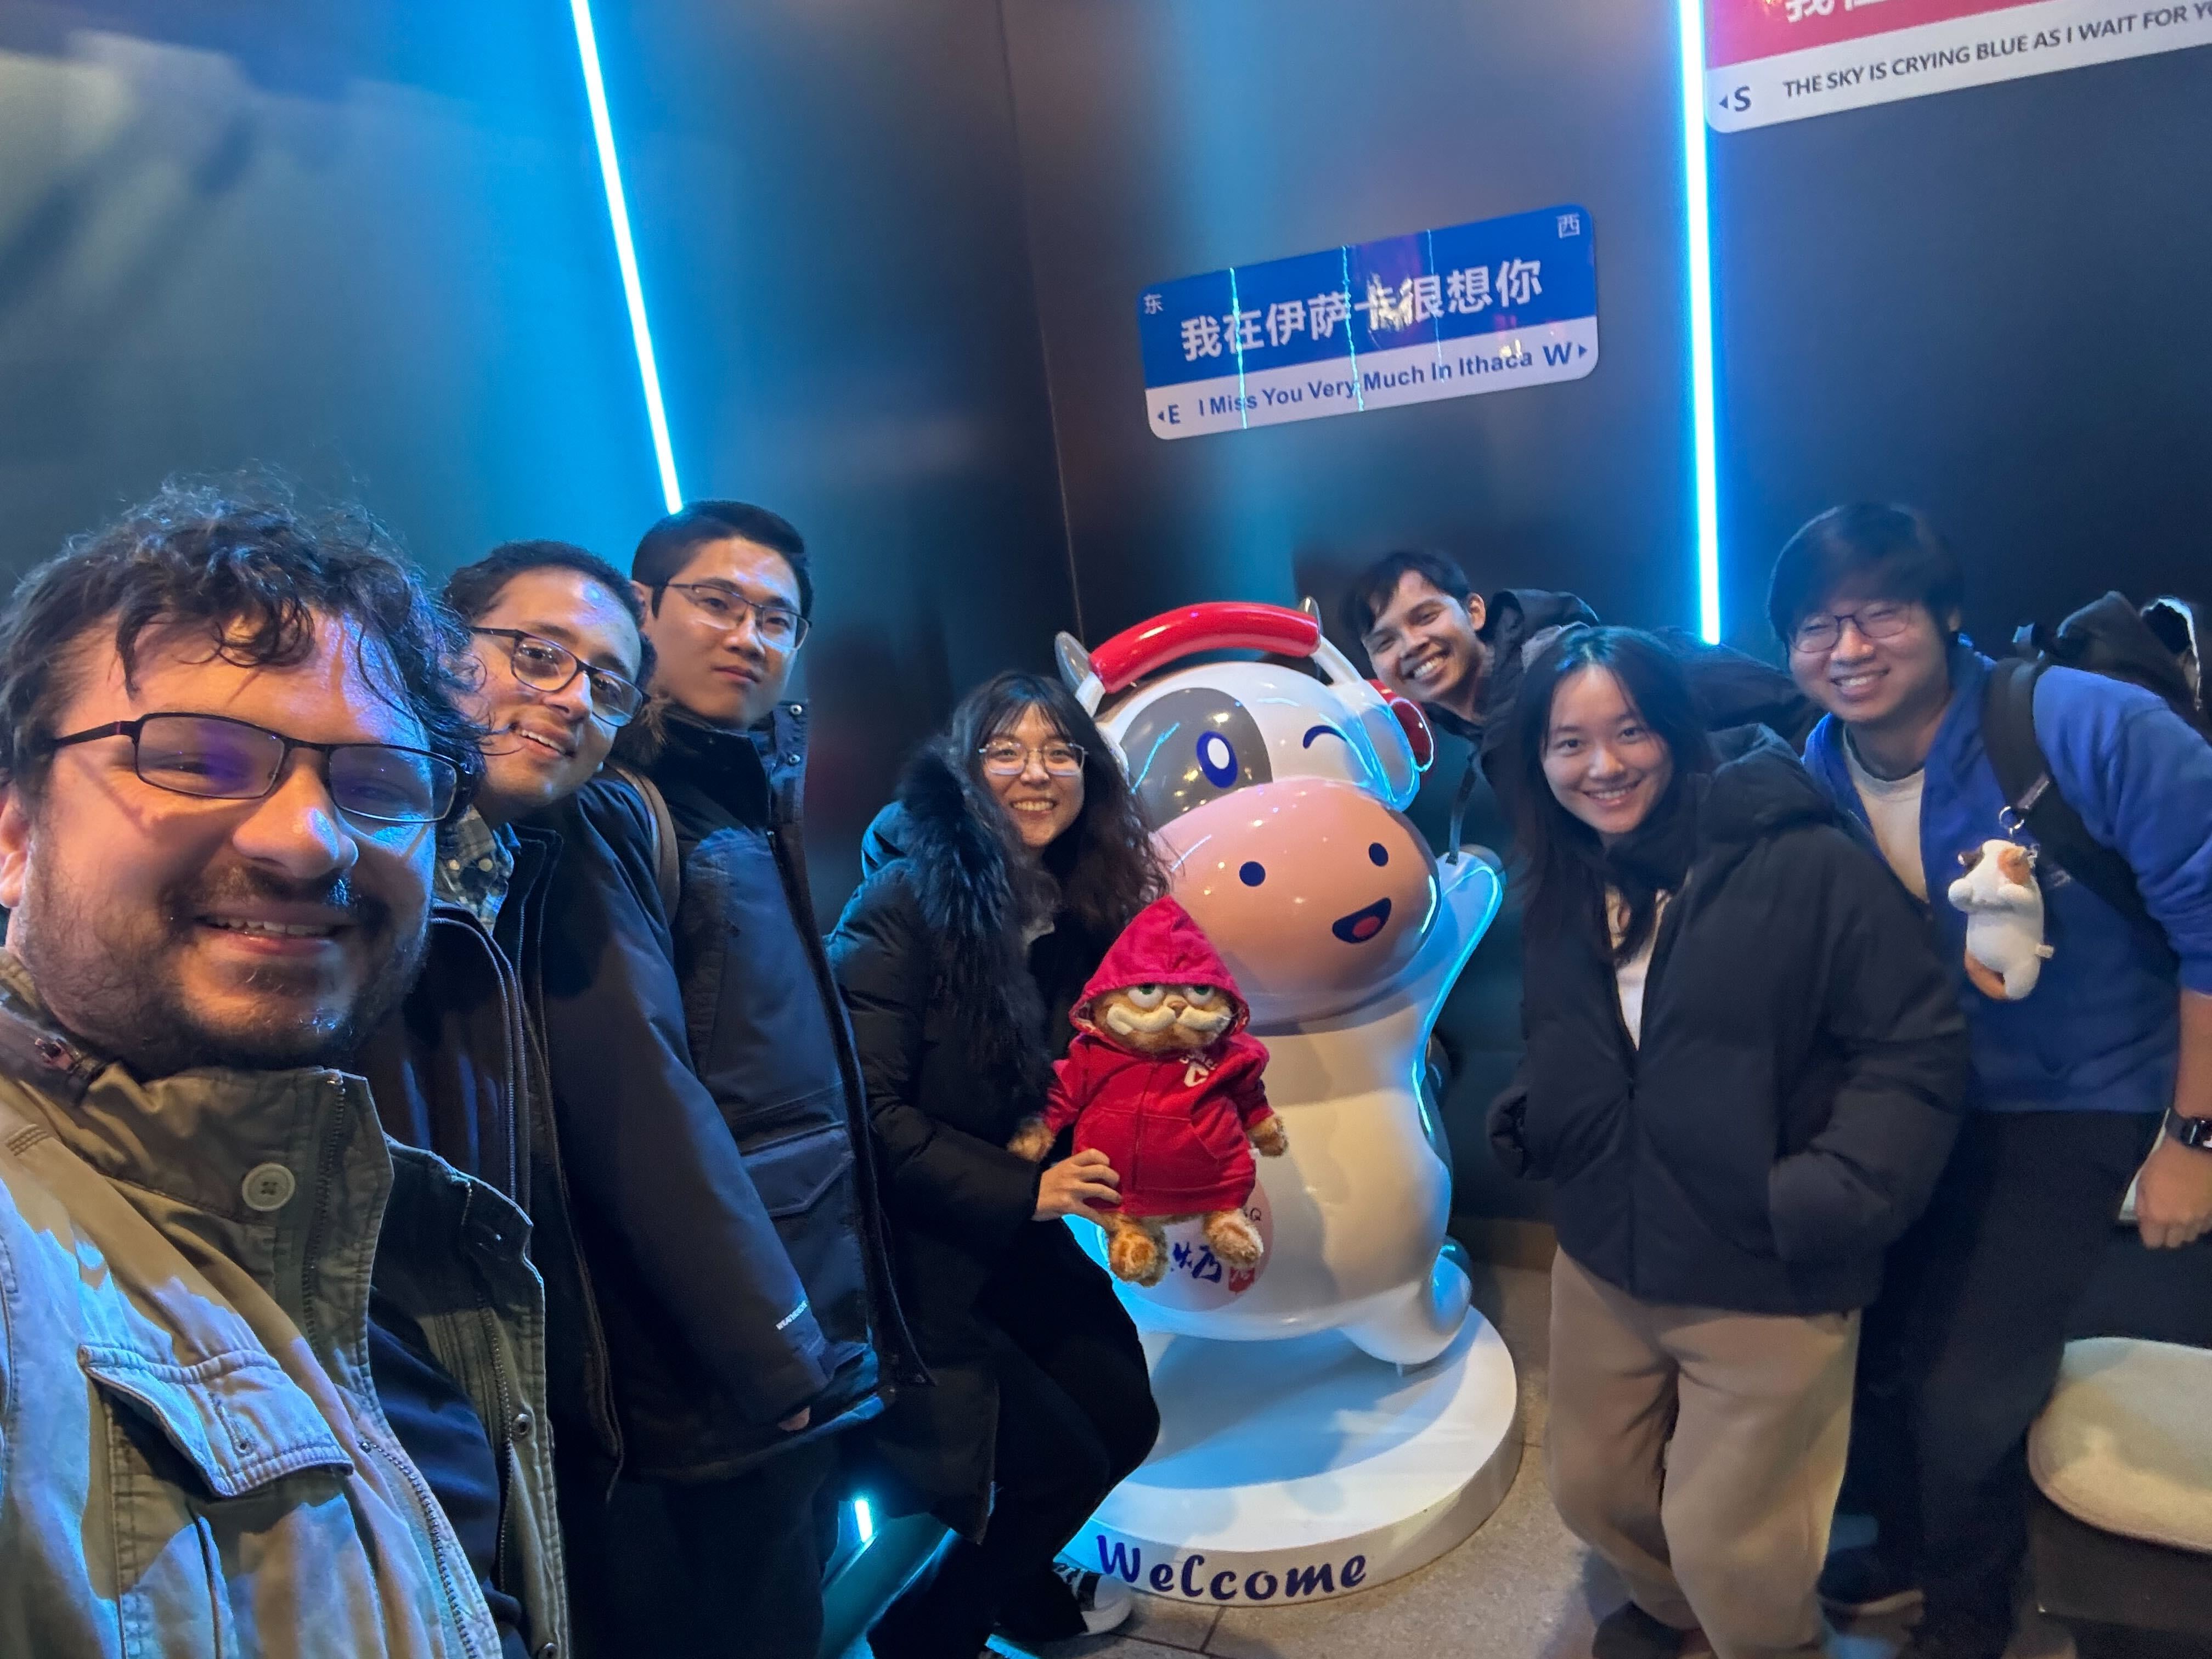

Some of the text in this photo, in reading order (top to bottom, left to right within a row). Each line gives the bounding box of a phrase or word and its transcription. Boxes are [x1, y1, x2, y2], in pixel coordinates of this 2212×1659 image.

[1782, 75, 1822, 98] THE
[1827, 66, 1865, 89] SKY
[1870, 61, 1887, 81] IS
[1892, 45, 1971, 76] CRYING
[1976, 35, 2028, 60] BLUE
[2033, 29, 2061, 49] AS
[2067, 26, 2072, 43] I
[2078, 14, 2137, 41] WAIT
[2143, 5, 2188, 30] FOR
[1734, 85, 1752, 112] S
[1556, 212, 1581, 239] 西
[1143, 294, 1164, 315] 东
[1543, 342, 1572, 366] W
[1198, 351, 1533, 416] I Miss You Very Much In Ithaca
[1168, 404, 1181, 425] E
[1097, 1534, 1367, 1601] Welcome
